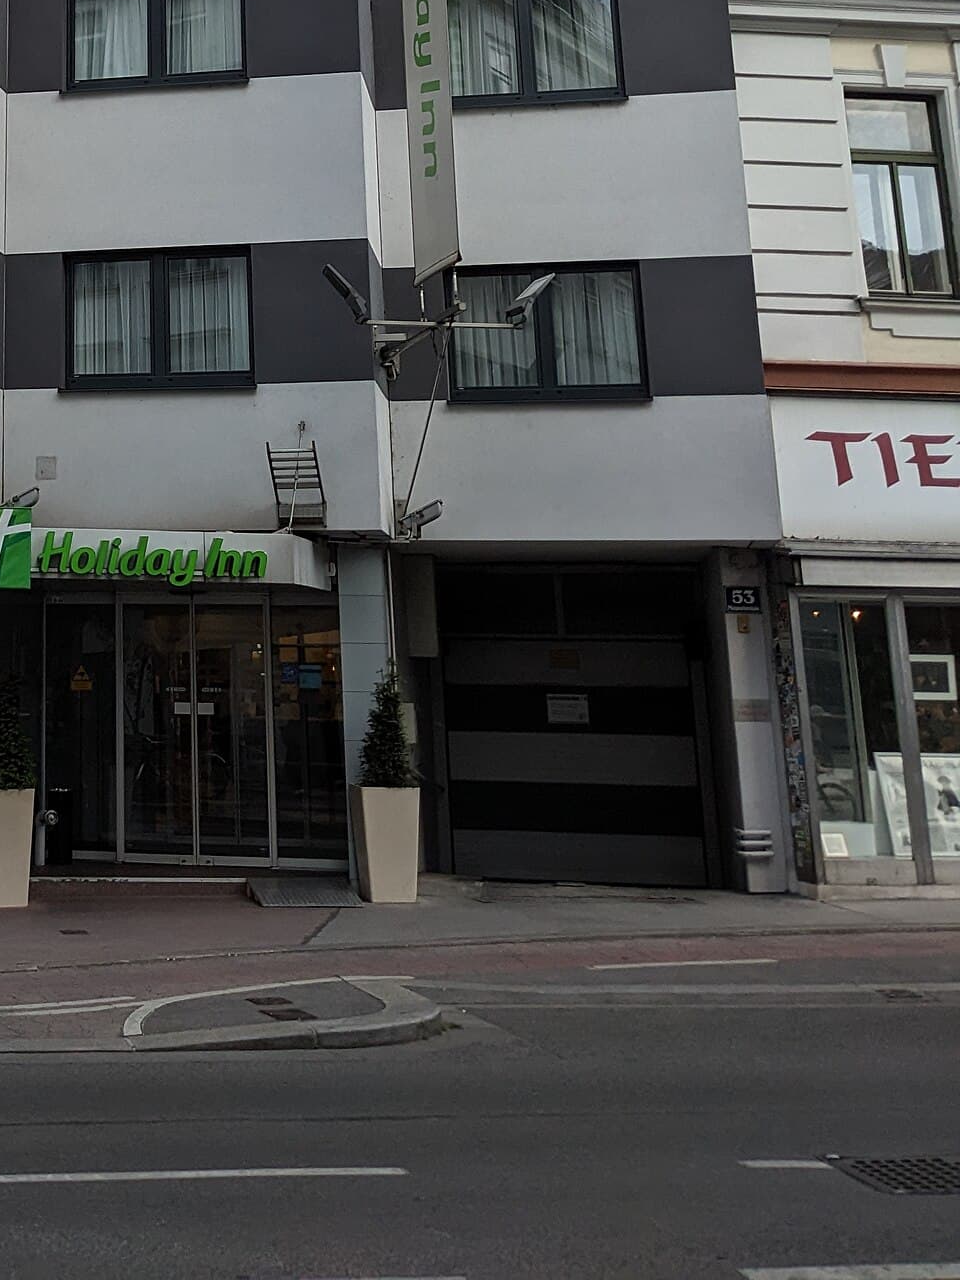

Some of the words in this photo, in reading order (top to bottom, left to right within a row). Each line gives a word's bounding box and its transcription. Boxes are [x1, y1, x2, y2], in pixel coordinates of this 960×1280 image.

[420, 78, 441, 178] Inn
[804, 430, 960, 488] TIE
[38, 530, 199, 587] Holiday
[205, 537, 269, 578] Inn
[731, 589, 756, 604] 53
